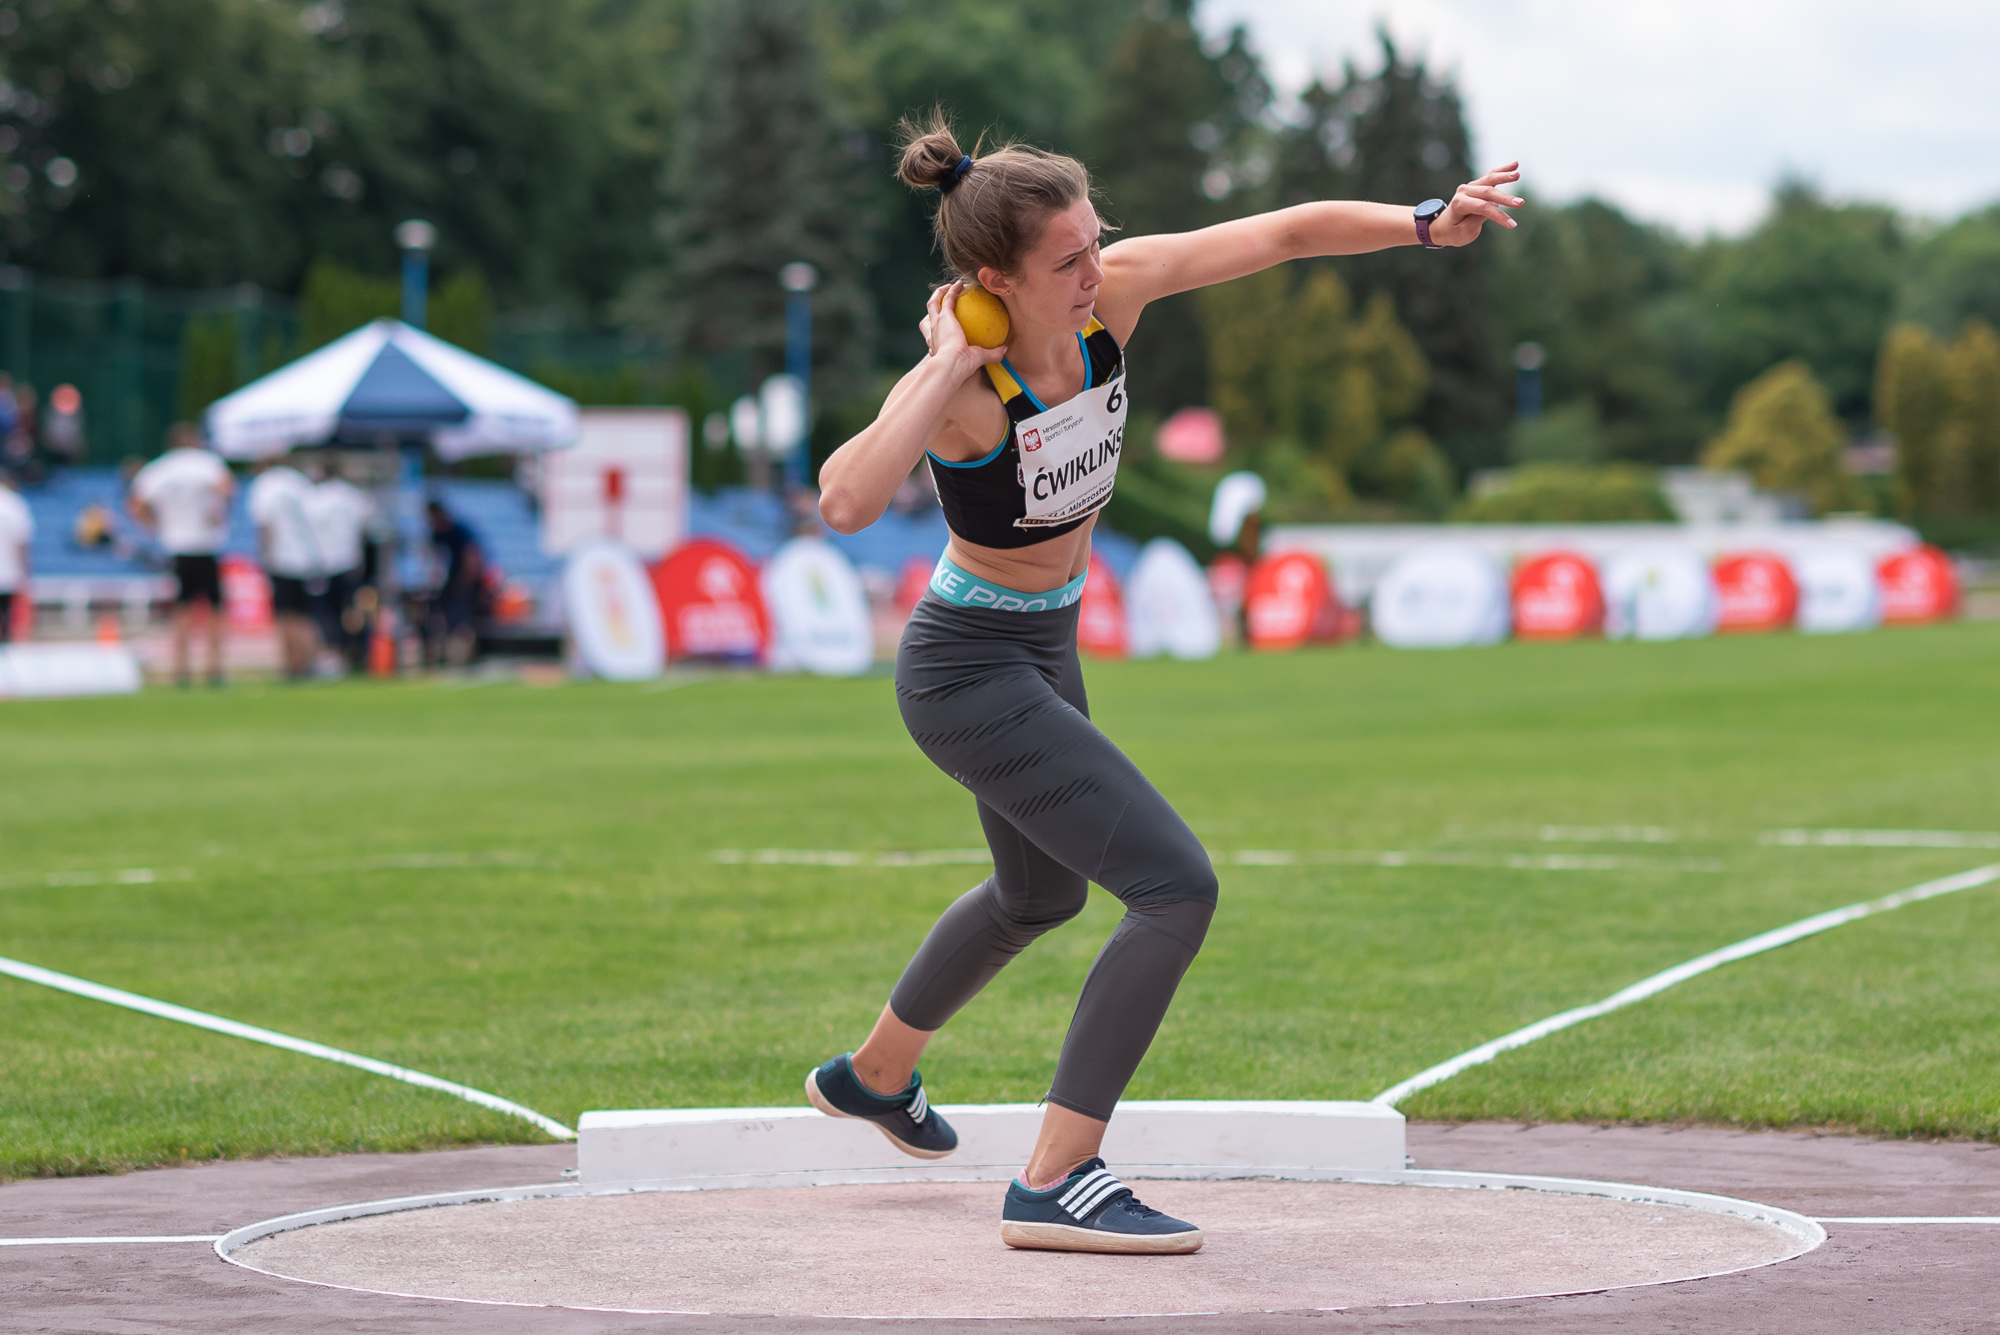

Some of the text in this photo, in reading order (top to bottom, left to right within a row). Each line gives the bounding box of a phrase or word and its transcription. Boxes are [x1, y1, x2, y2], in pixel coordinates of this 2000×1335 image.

[1106, 382, 1125, 413] 6
[1042, 415, 1073, 434] Ministerstwo
[1033, 421, 1124, 501] ĆWIKLIŃS
[933, 559, 966, 595] KE
[962, 585, 1048, 613] PRO
